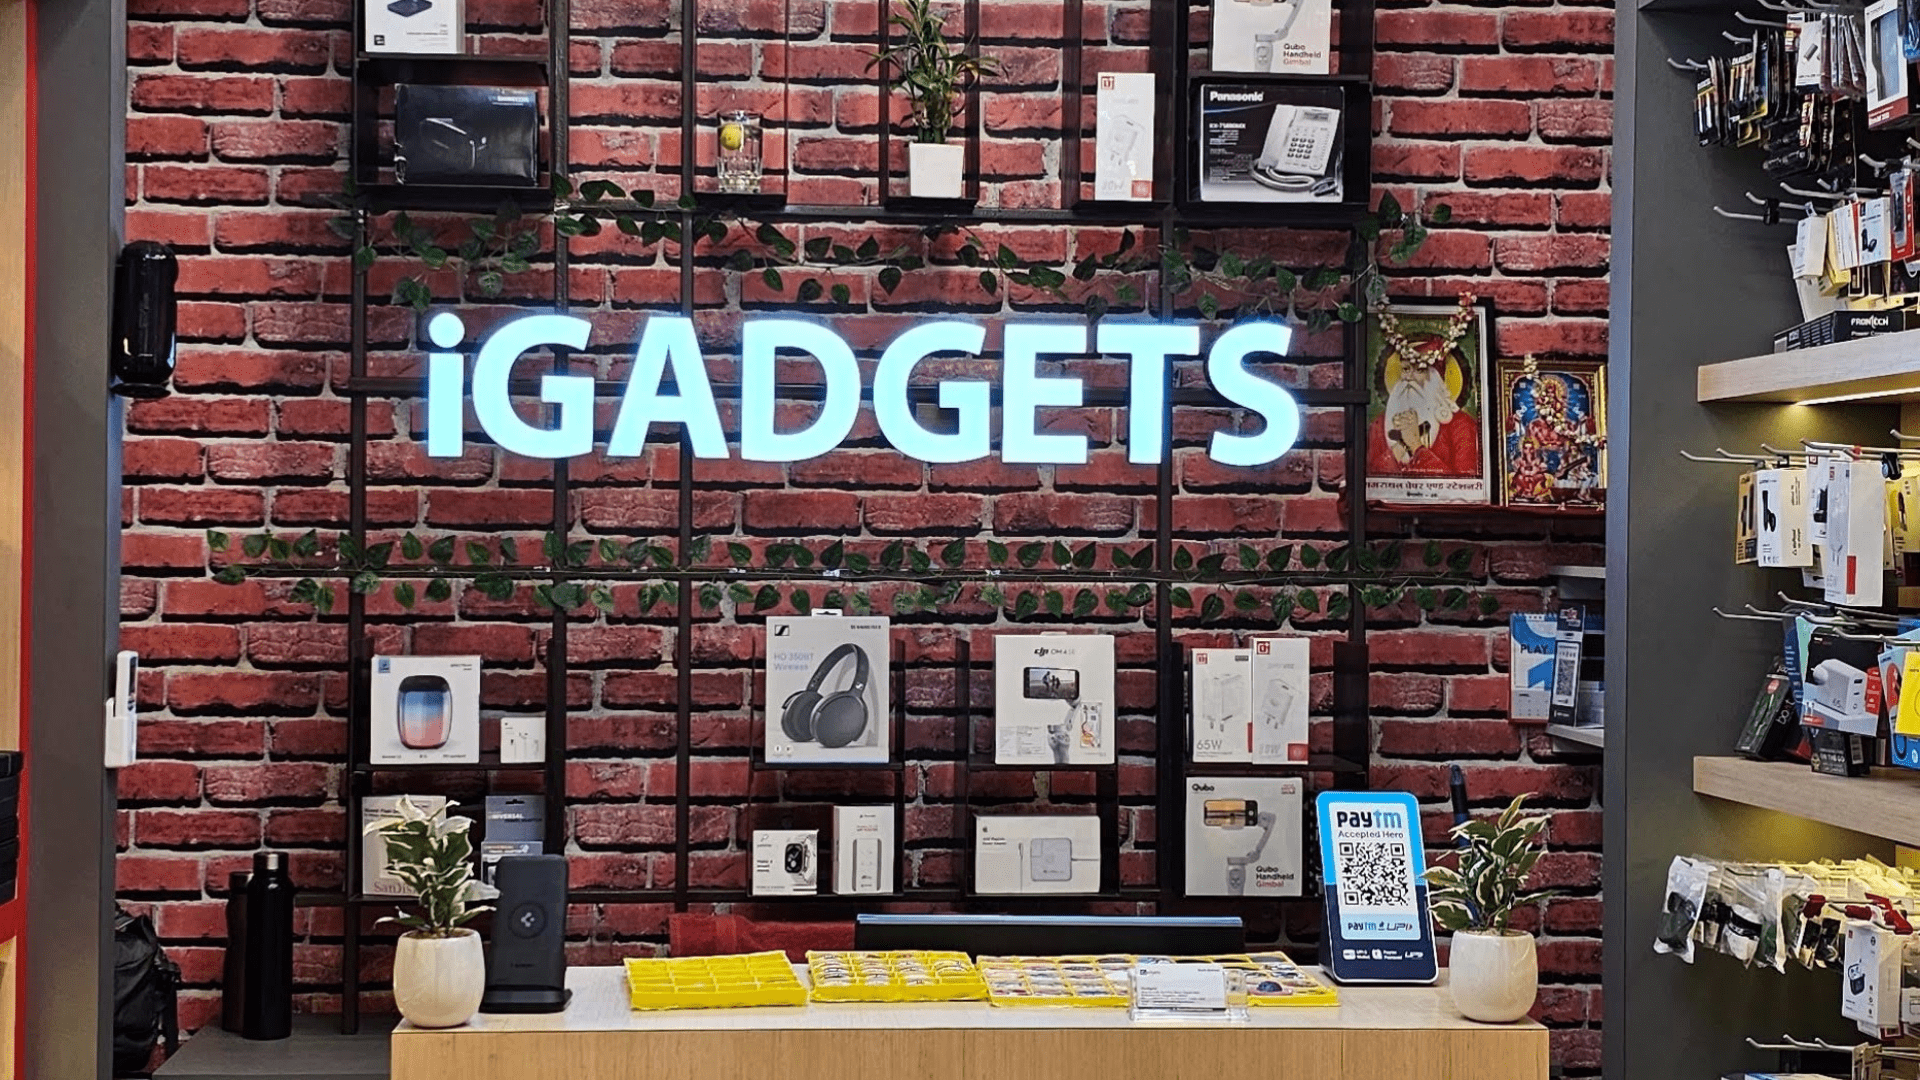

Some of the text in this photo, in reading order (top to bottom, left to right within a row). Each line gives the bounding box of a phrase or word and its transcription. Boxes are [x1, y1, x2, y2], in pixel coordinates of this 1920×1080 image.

[1209, 91, 1264, 102] Panasonic
[426, 311, 1302, 467] iGADGETS
[1519, 643, 1549, 655] PLAY
[1196, 739, 1222, 750] 65W
[1192, 783, 1215, 792] Qubo
[1338, 830, 1404, 839] Accepted Here
[1256, 865, 1279, 873] Qubo
